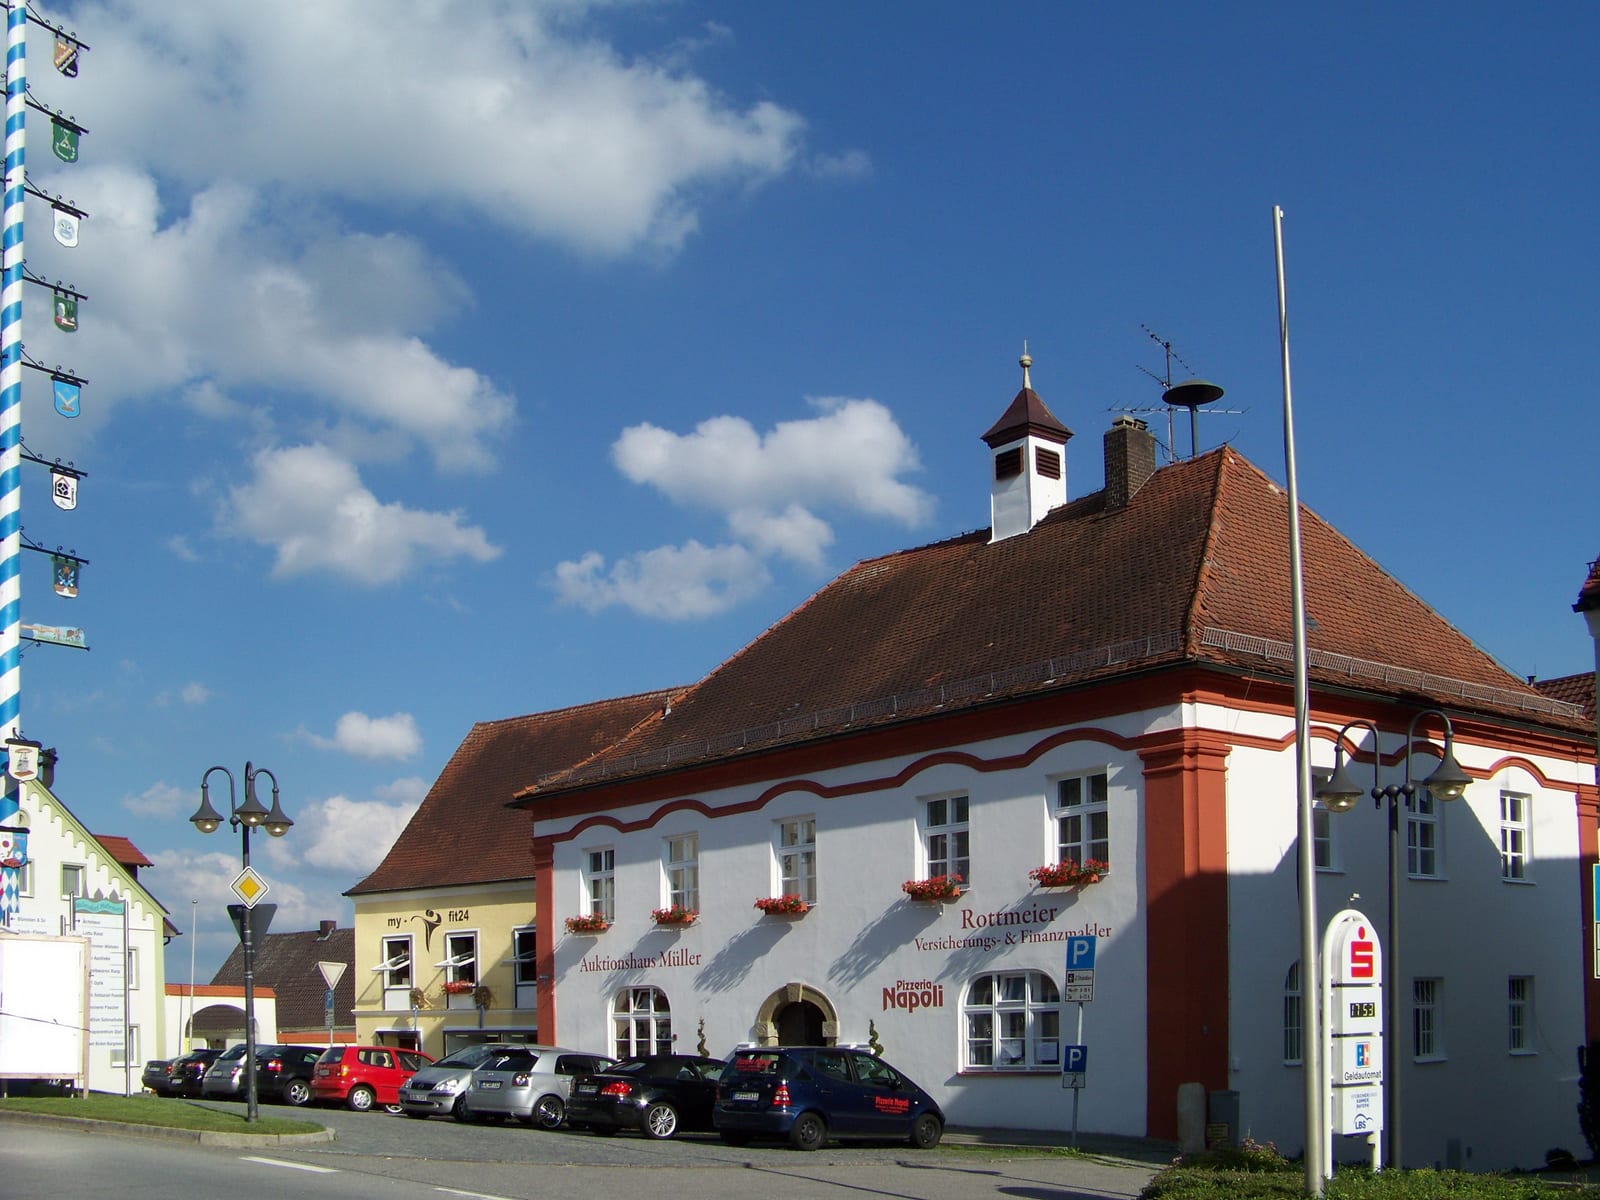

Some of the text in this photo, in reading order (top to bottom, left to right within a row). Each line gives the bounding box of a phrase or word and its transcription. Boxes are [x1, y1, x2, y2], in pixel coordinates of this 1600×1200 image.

[387, 909, 470, 929] my fit24
[960, 903, 1058, 930] Rottmeier
[914, 922, 1112, 953] Versicherungs- & Finanzmakler
[579, 948, 702, 973] Auktionshaus Müller
[1072, 939, 1090, 965] P
[896, 978, 932, 991] Pizzeria
[882, 985, 944, 1013] Napoli
[1069, 1048, 1083, 1070] P
[1344, 1070, 1382, 1081] Geldautomat
[1355, 1120, 1367, 1130] LBS
